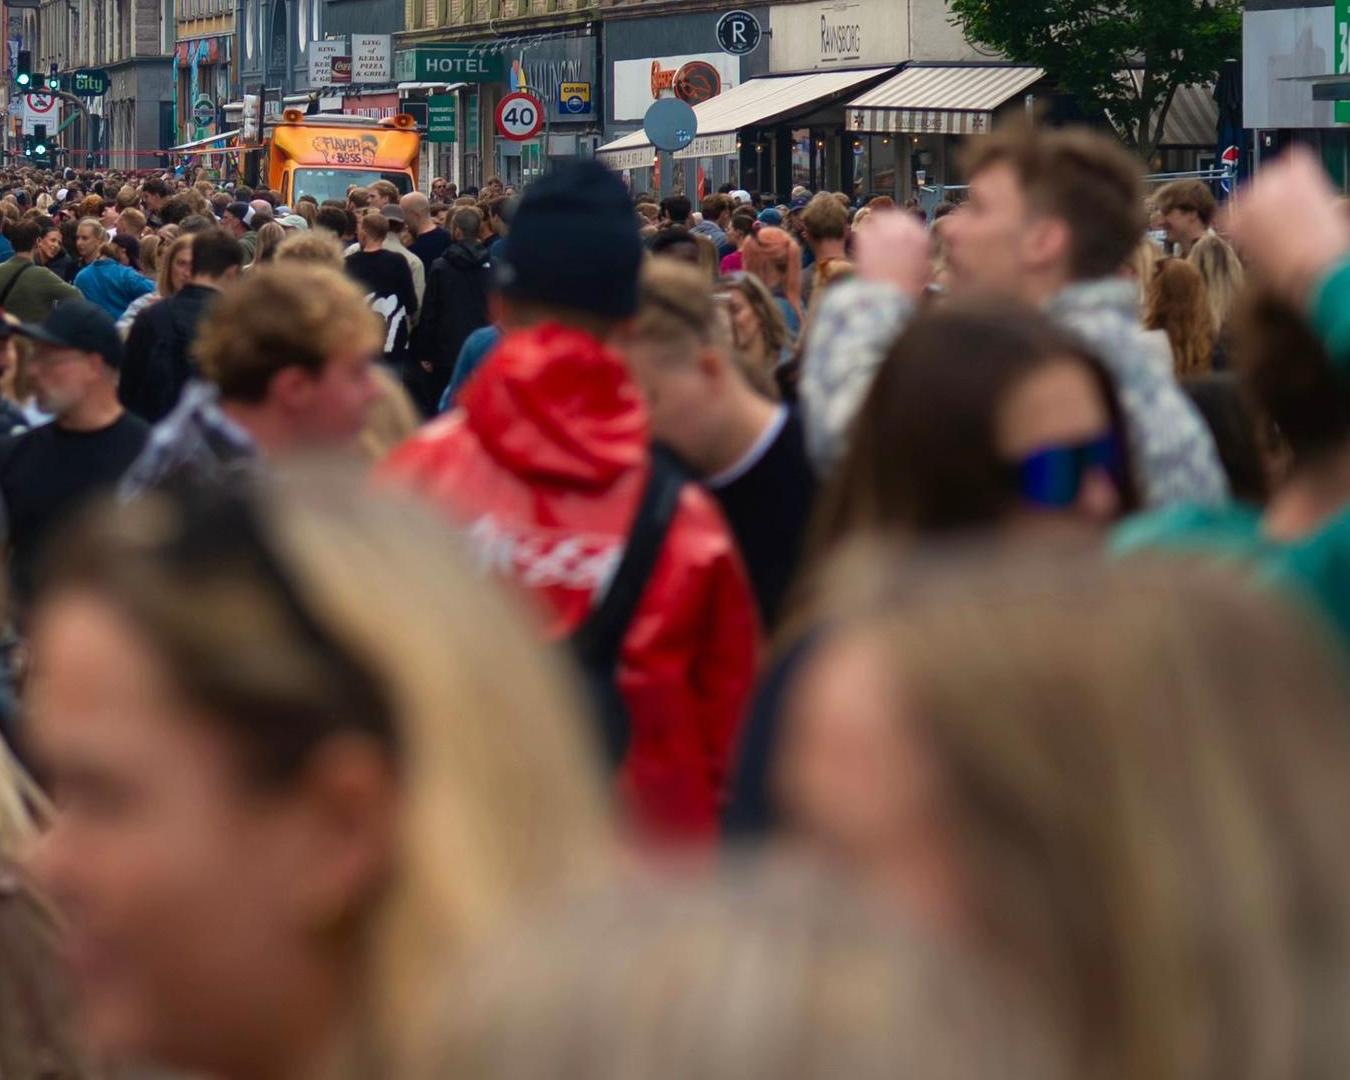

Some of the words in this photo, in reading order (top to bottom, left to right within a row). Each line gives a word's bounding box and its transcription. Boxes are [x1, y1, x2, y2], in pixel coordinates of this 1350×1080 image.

[732, 21, 747, 43] R
[425, 58, 490, 72] HOTEL
[76, 76, 103, 93] city
[503, 107, 534, 126] 40
[337, 152, 362, 164] BOSS
